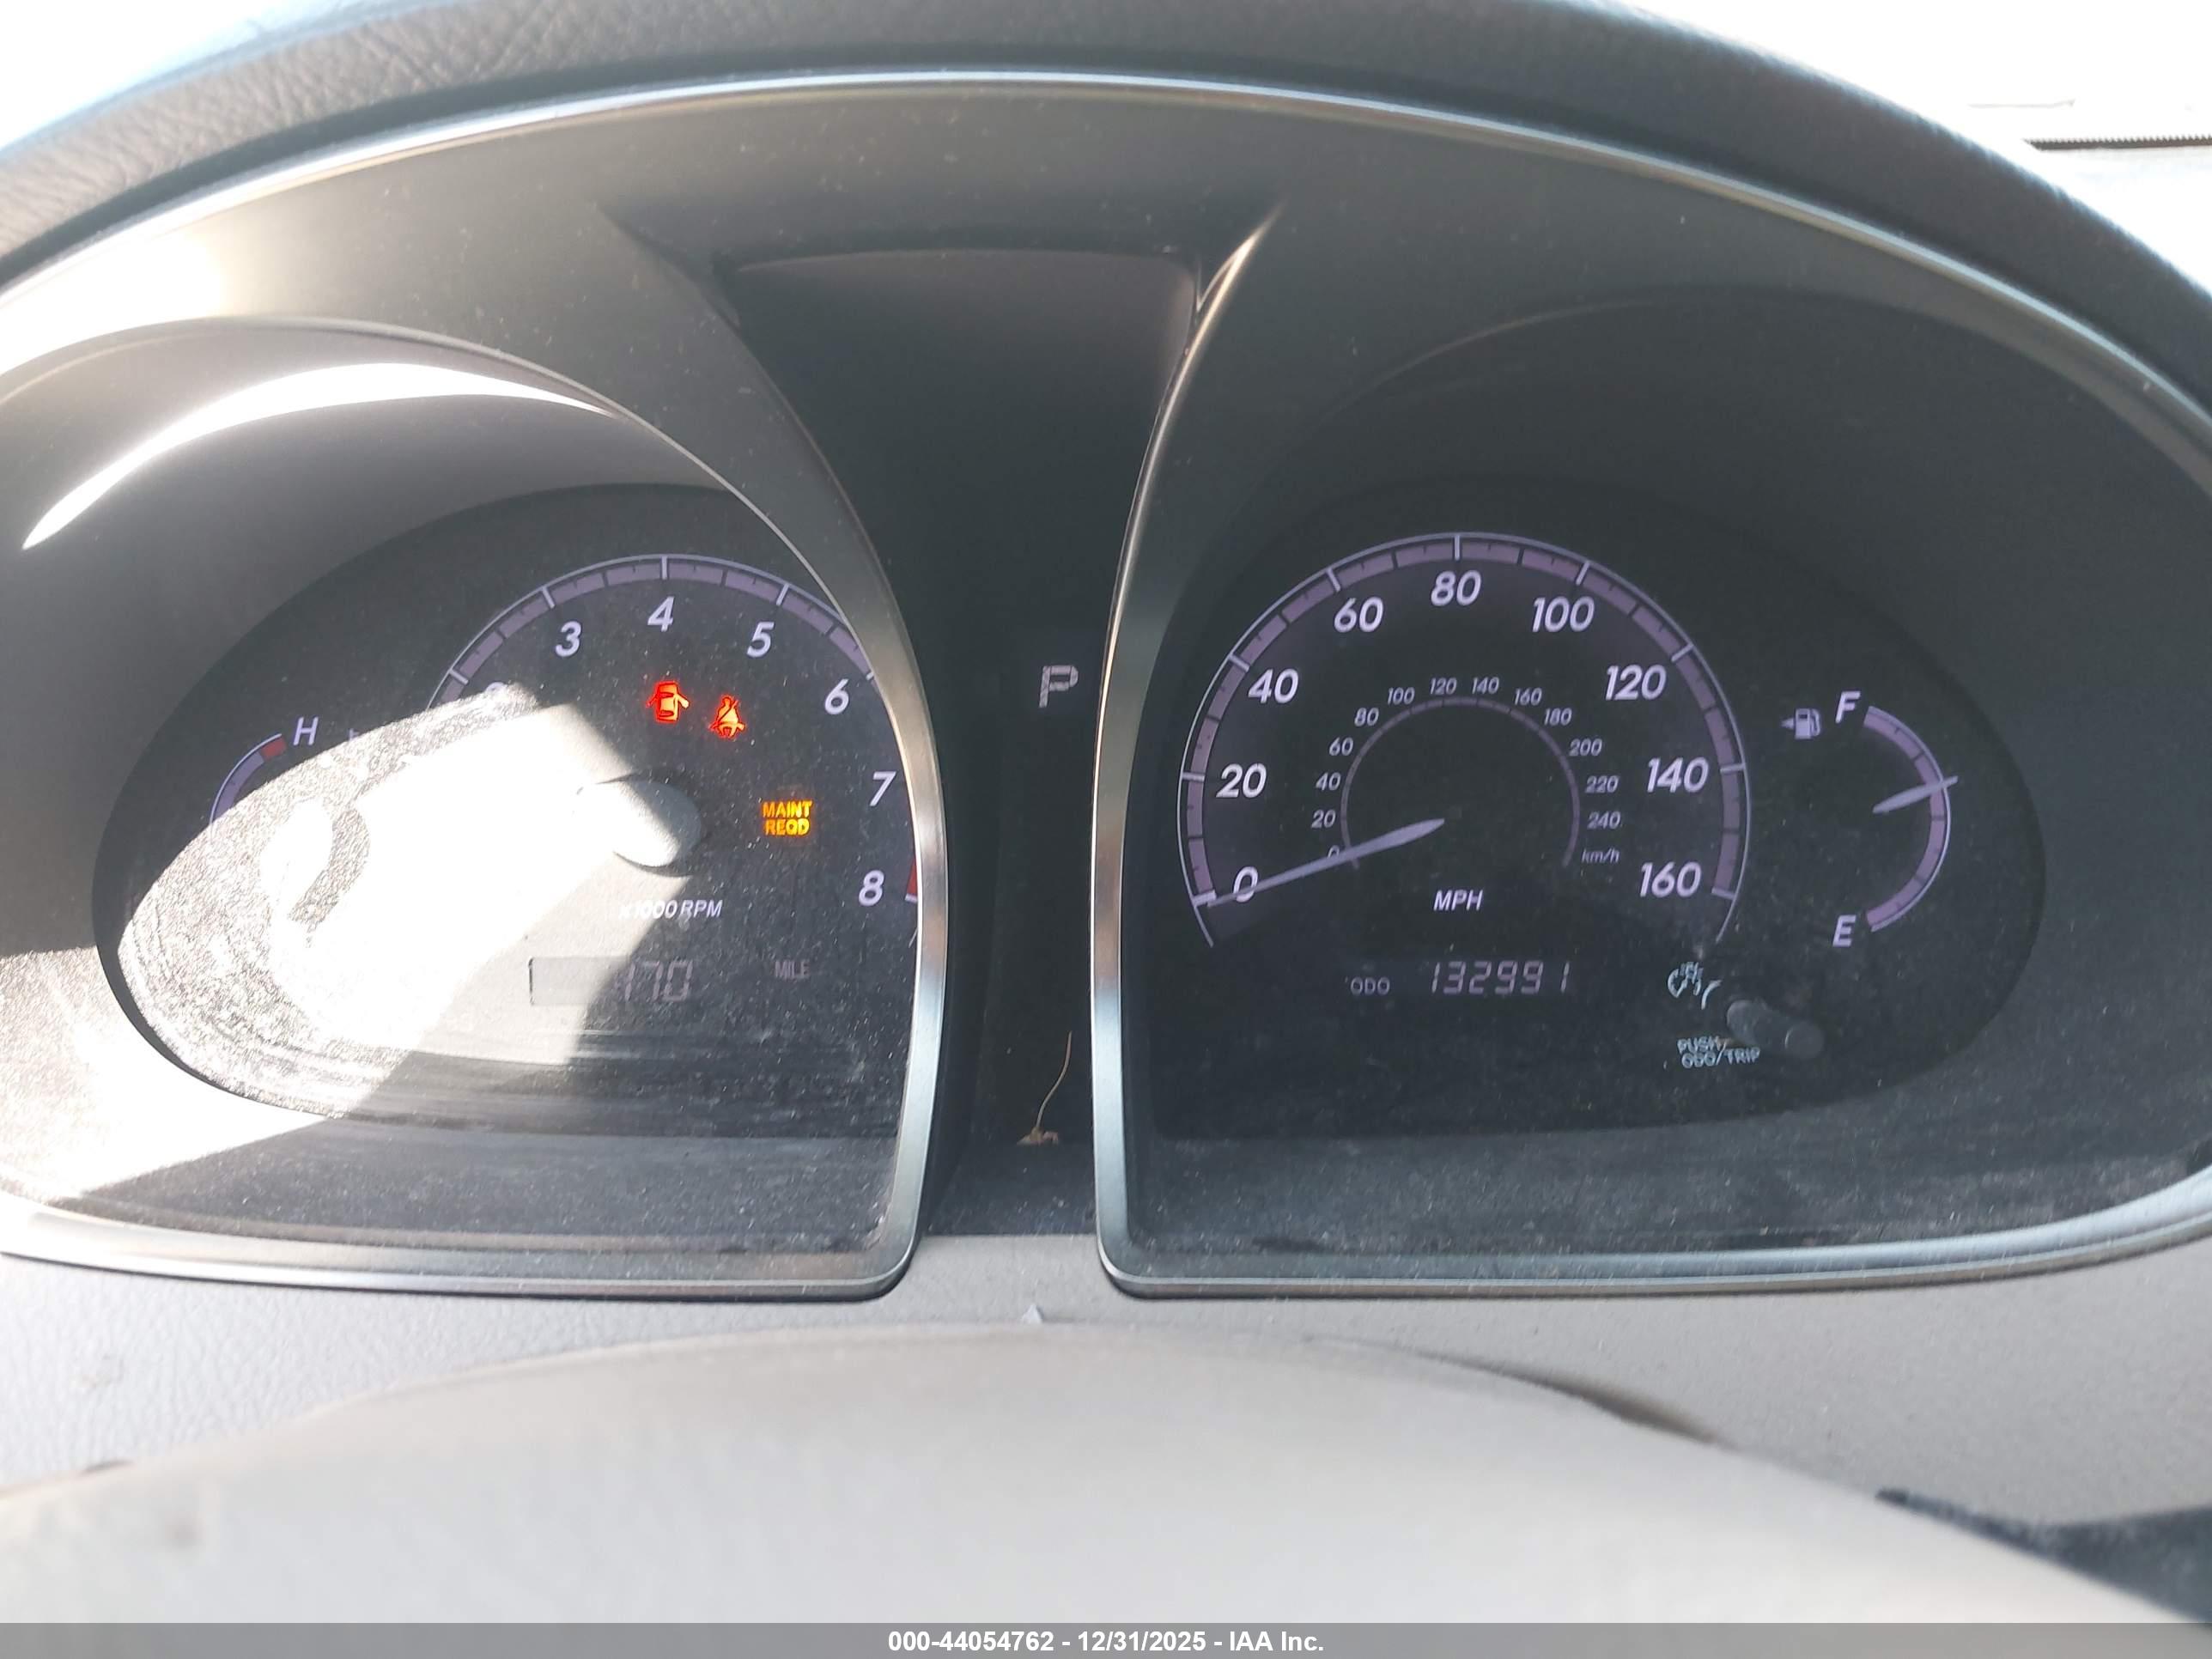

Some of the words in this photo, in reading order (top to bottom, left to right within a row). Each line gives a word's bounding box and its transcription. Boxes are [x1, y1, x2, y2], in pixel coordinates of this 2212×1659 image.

[1431, 570, 1482, 606] 80
[647, 596, 674, 632] 4
[1334, 597, 1384, 633] 60
[1532, 596, 1595, 633] 100
[555, 621, 581, 657] 3
[746, 622, 775, 658] 5
[824, 678, 849, 715] 6
[1039, 665, 1079, 708] P
[1248, 668, 1299, 703] 40
[1387, 687, 1415, 705] 100
[1430, 678, 1457, 695] 120
[1472, 677, 1500, 695] 140
[1514, 687, 1543, 706] 160
[1605, 665, 1667, 701] 120
[1354, 707, 1379, 726] 80
[1544, 708, 1572, 726] 180
[1835, 690, 1861, 724] F
[293, 716, 319, 746] H
[1328, 737, 1354, 757] 60
[1569, 738, 1603, 757] 200
[870, 771, 896, 806] 7
[1216, 763, 1267, 798] 20
[1316, 772, 1341, 791] 40
[1585, 775, 1620, 793] 220
[1647, 757, 1709, 793] 140
[762, 800, 812, 818] MAINT
[1311, 810, 1336, 828] 20
[1588, 811, 1621, 830] 240
[764, 818, 811, 836] REQD
[1582, 848, 1620, 864] km/h
[858, 870, 884, 906] 8
[1232, 866, 1258, 902] 0
[1640, 861, 1702, 897] 160
[680, 899, 723, 919] RPM
[1433, 890, 1484, 911] MPH
[1832, 915, 1856, 947] E
[775, 960, 810, 980] MILE
[1350, 977, 1390, 995] ODO
[1431, 960, 1570, 994] 132991
[1681, 1041, 1760, 1068] ODO/TRIP
